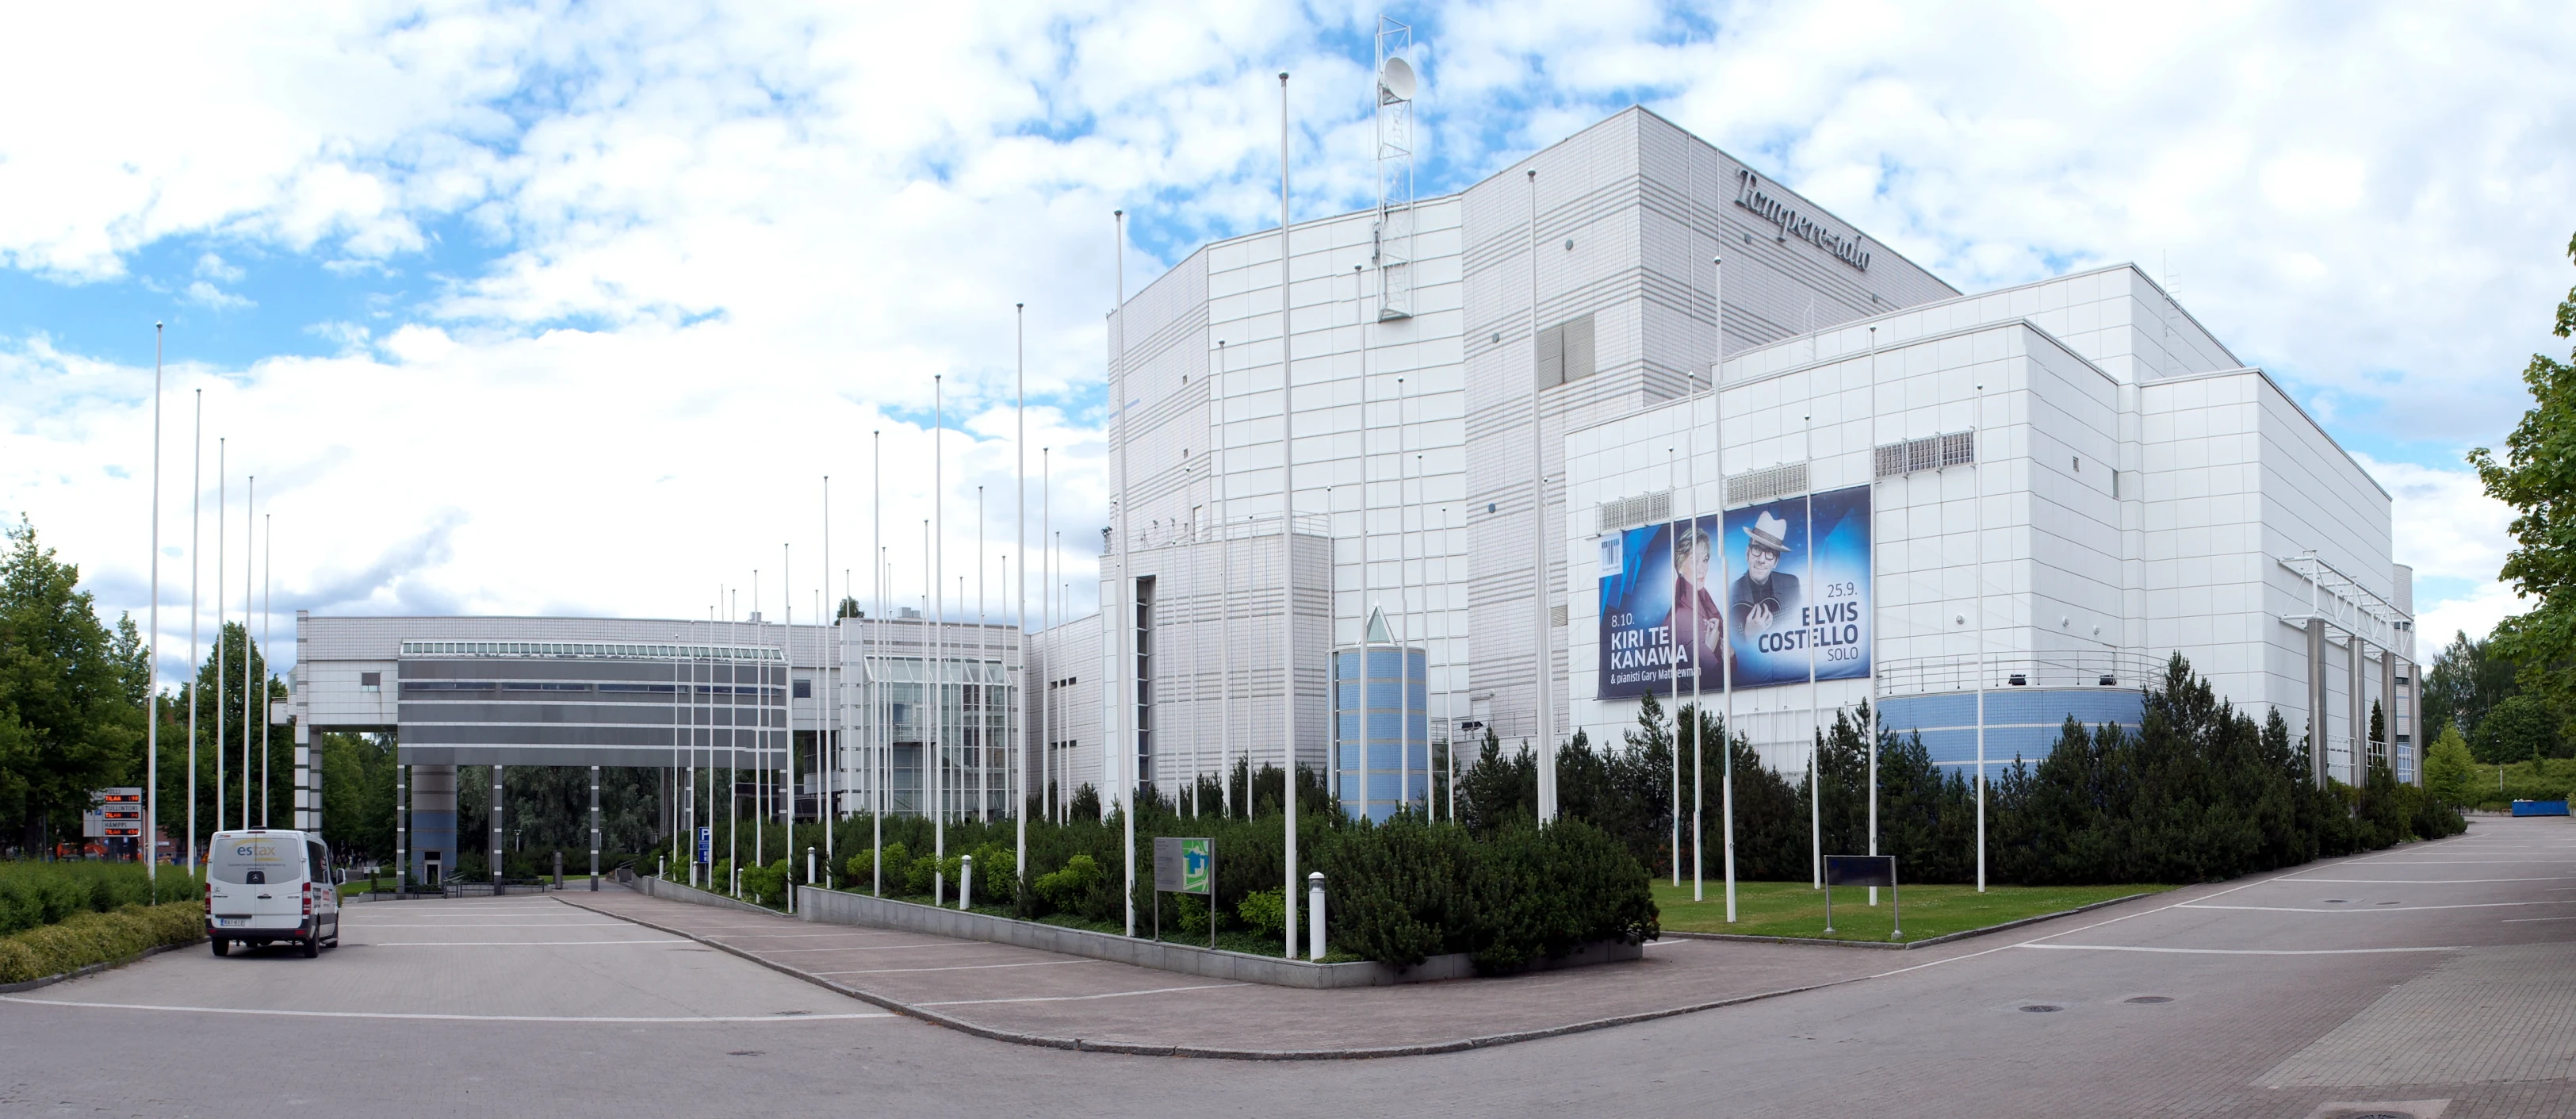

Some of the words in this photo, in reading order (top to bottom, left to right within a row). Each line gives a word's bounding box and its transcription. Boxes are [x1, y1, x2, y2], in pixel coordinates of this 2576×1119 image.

[1827, 581, 1858, 598] 25.9.
[1611, 612, 1635, 628] 8.10.
[1802, 601, 1858, 627] ELVIS
[1611, 629, 1644, 650] KIRI
[1648, 626, 1670, 646] TE
[1758, 623, 1858, 653] COSTELLO
[1611, 644, 1689, 670] KANAWA
[1828, 646, 1858, 661] SOLO
[1610, 673, 1616, 684] &
[1617, 671, 1640, 685] pianisti
[1641, 670, 1657, 682] Gary
[1658, 667, 1701, 680] Mattewmn
[237, 846, 276, 856] estax
